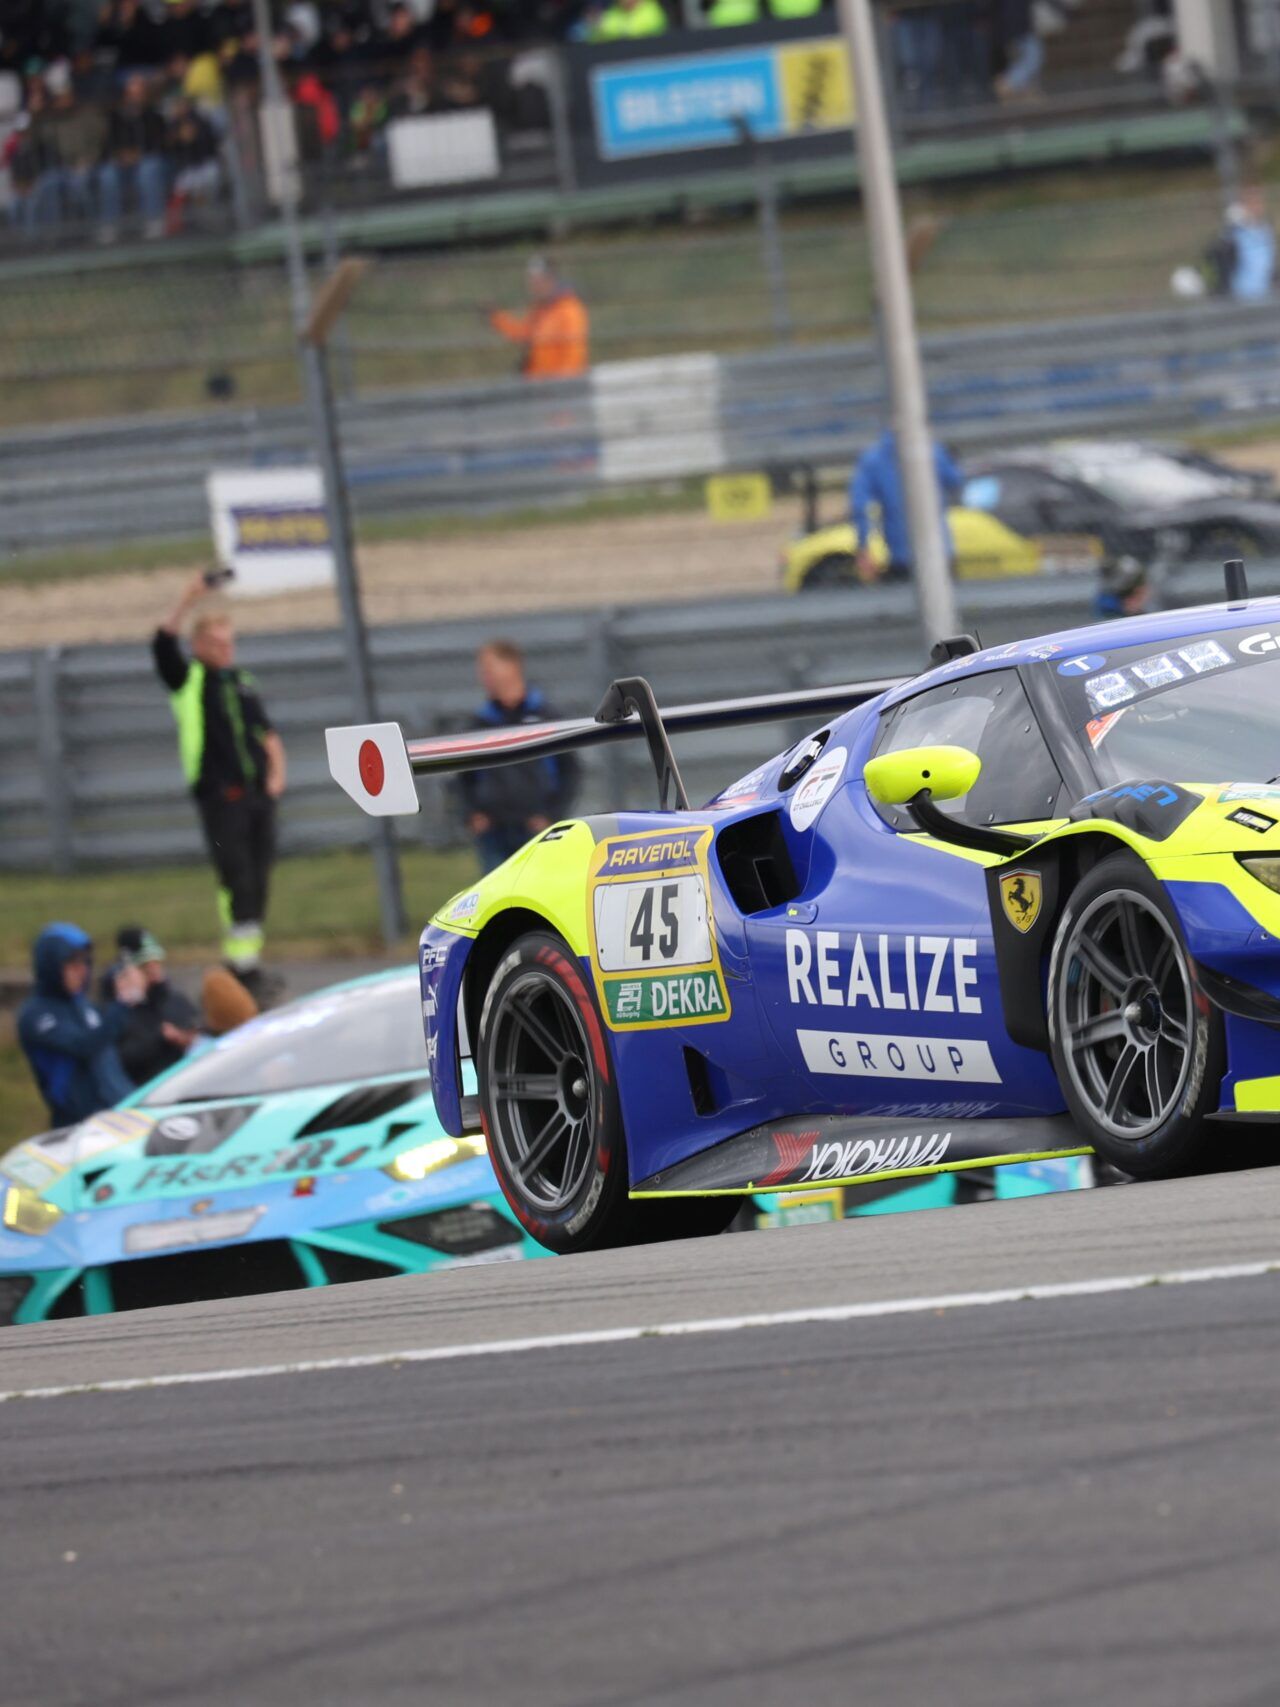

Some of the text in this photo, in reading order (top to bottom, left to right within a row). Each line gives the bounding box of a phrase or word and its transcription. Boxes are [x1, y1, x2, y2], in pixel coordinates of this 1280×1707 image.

[1063, 656, 1091, 672] T
[609, 840, 691, 867] RAVENOL
[630, 884, 679, 961] 45
[785, 928, 983, 1014] REALIZE
[652, 975, 724, 1017] DEKRA
[828, 1038, 964, 1074] GROUP
[798, 1132, 952, 1182] YOKOHAMA
